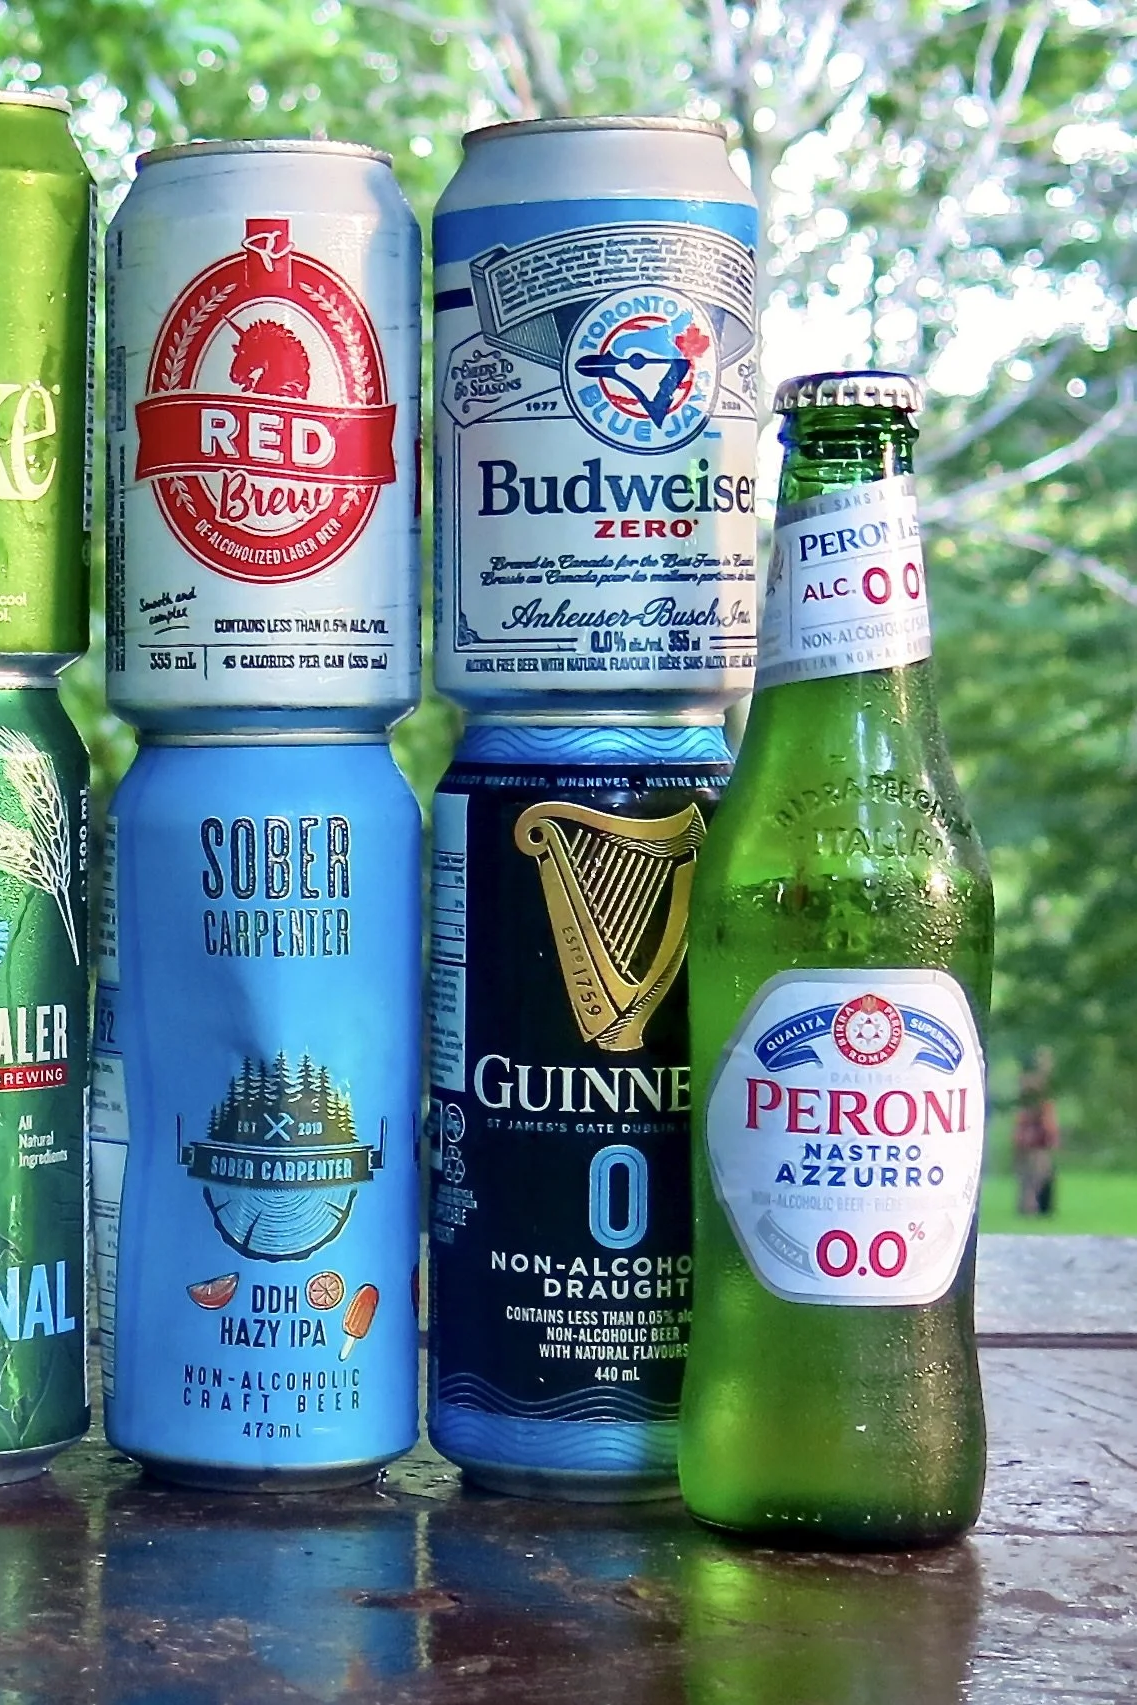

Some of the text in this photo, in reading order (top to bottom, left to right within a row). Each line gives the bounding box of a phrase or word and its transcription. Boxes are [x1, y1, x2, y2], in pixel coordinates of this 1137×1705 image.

[578, 295, 679, 350] TORONTO
[526, 401, 558, 411] 1977
[577, 383, 652, 442] BLUE
[200, 408, 336, 468] RED
[220, 472, 331, 522] Brew
[194, 517, 343, 565] DE-ALCOHOLIZED LAGER BEER
[594, 520, 693, 539] ZERO
[175, 587, 198, 604] and
[802, 577, 857, 604] ALC.
[215, 618, 265, 633] CONTAINS
[267, 619, 292, 633] LESS
[295, 619, 322, 633] THAN
[174, 652, 197, 669] mL
[222, 655, 344, 669] 45 CALORIES PER CAN
[496, 657, 608, 672] FREE BEER WITH NATURAL
[200, 815, 351, 900] SOBER
[202, 908, 351, 957] CARPENTER
[571, 968, 602, 1017] 1759
[766, 1014, 827, 1052] QUALITÀ
[835, 1005, 855, 1049] BIRRA
[848, 1049, 888, 1064] ROMA
[473, 1054, 691, 1113] GUINNE
[745, 1078, 969, 1137] PERONI
[18, 1115, 33, 1131] All
[237, 1120, 257, 1134] EST
[487, 1118, 614, 1134] ST JAMES'S GATE
[18, 1131, 54, 1149] Natural
[803, 1143, 922, 1163] NASTRO
[18, 1149, 68, 1169] Ingredients
[210, 1155, 352, 1182] SOBER CARPENTER
[775, 1163, 944, 1188] AZZURRO
[589, 1144, 648, 1250] 0
[816, 1221, 926, 1278] 0.0%
[491, 1251, 692, 1278] NON-ALCOHO
[251, 1284, 298, 1315] DDH
[543, 1278, 690, 1300] DRAUGHT
[506, 1306, 675, 1326] CONTAINS LESS THAN 0.05%
[220, 1317, 327, 1348] HAZY IPA
[546, 1327, 680, 1343] NON-ALCOHOLIC BEER
[539, 1343, 689, 1361] WITH NATURAL FLAVOURS
[184, 1365, 361, 1392] NON-ALCOHOLIC
[594, 1367, 640, 1382] 440 mL
[183, 1387, 360, 1414] CRAFT BEER
